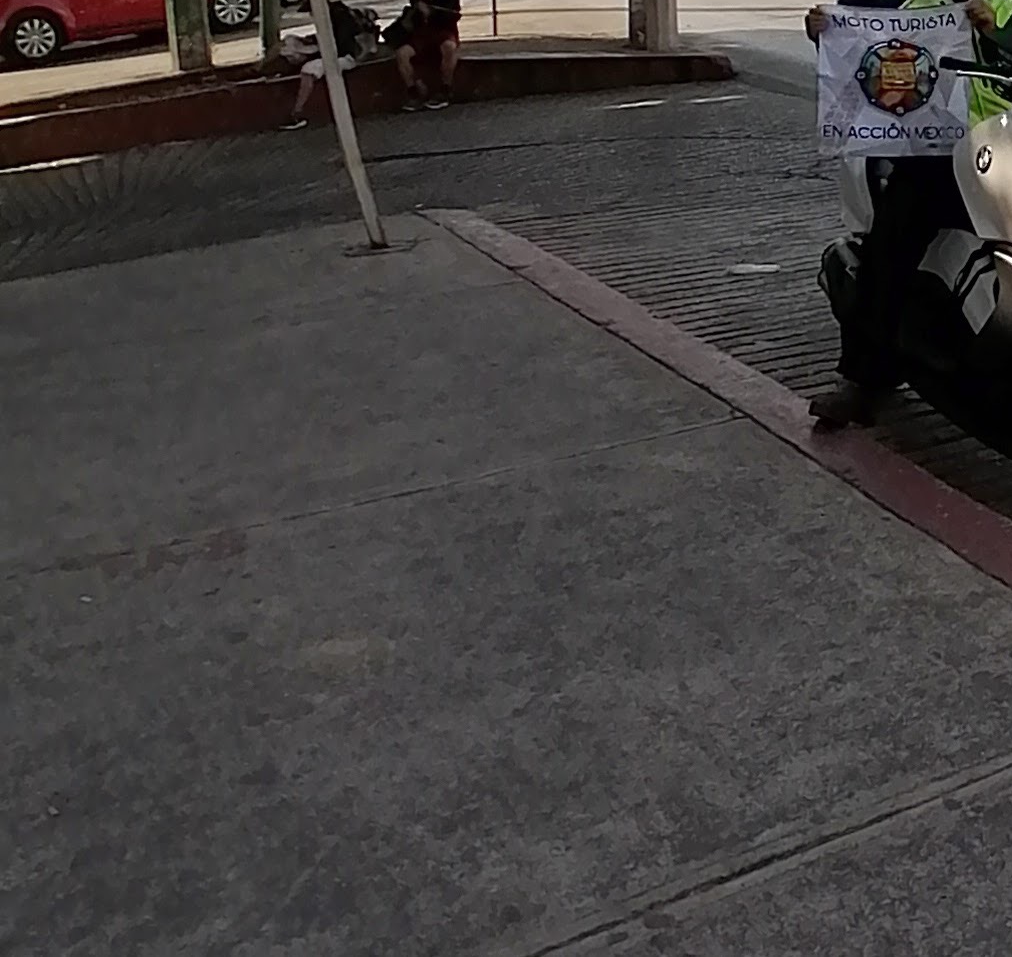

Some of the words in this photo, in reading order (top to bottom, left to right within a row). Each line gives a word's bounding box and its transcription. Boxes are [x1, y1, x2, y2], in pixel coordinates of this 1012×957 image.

[832, 14, 884, 31] MOTO
[889, 12, 957, 32] TURISTA
[823, 124, 842, 138] EN
[847, 122, 911, 139] ACCIÓN
